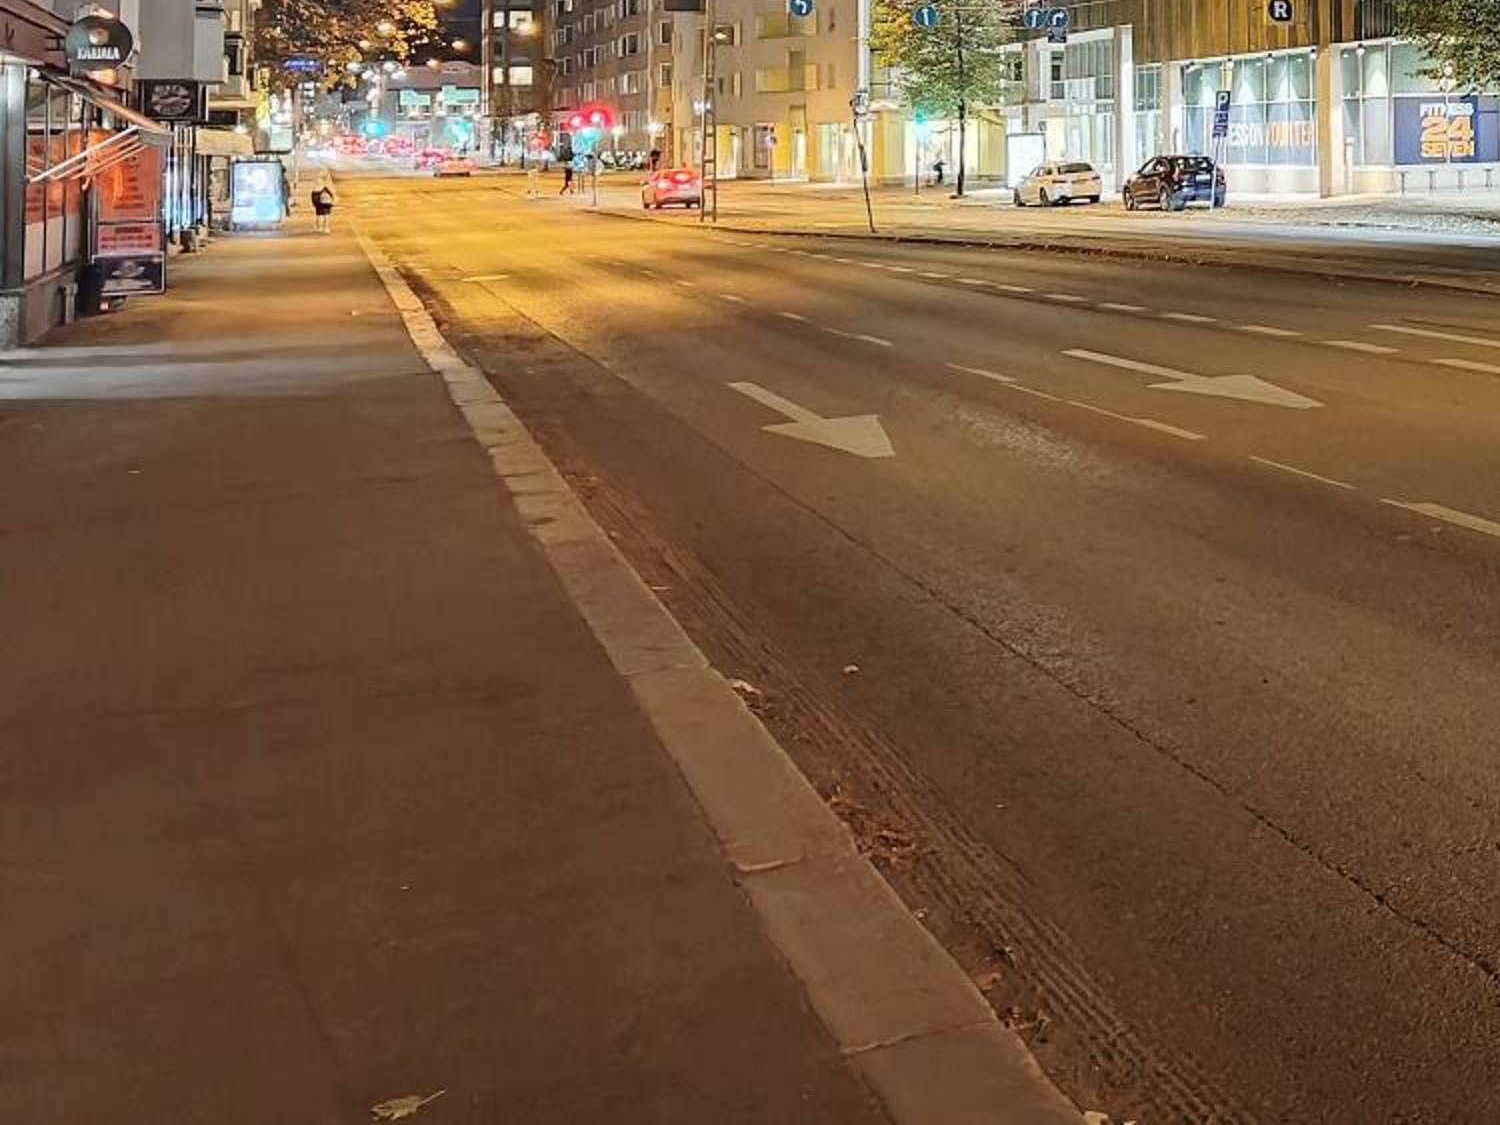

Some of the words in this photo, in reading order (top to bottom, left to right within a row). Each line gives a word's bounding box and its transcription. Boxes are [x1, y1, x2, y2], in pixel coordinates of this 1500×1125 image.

[1273, 1, 1288, 18] R
[1420, 116, 1475, 141] 24
[1420, 140, 1475, 158] SEVEN
